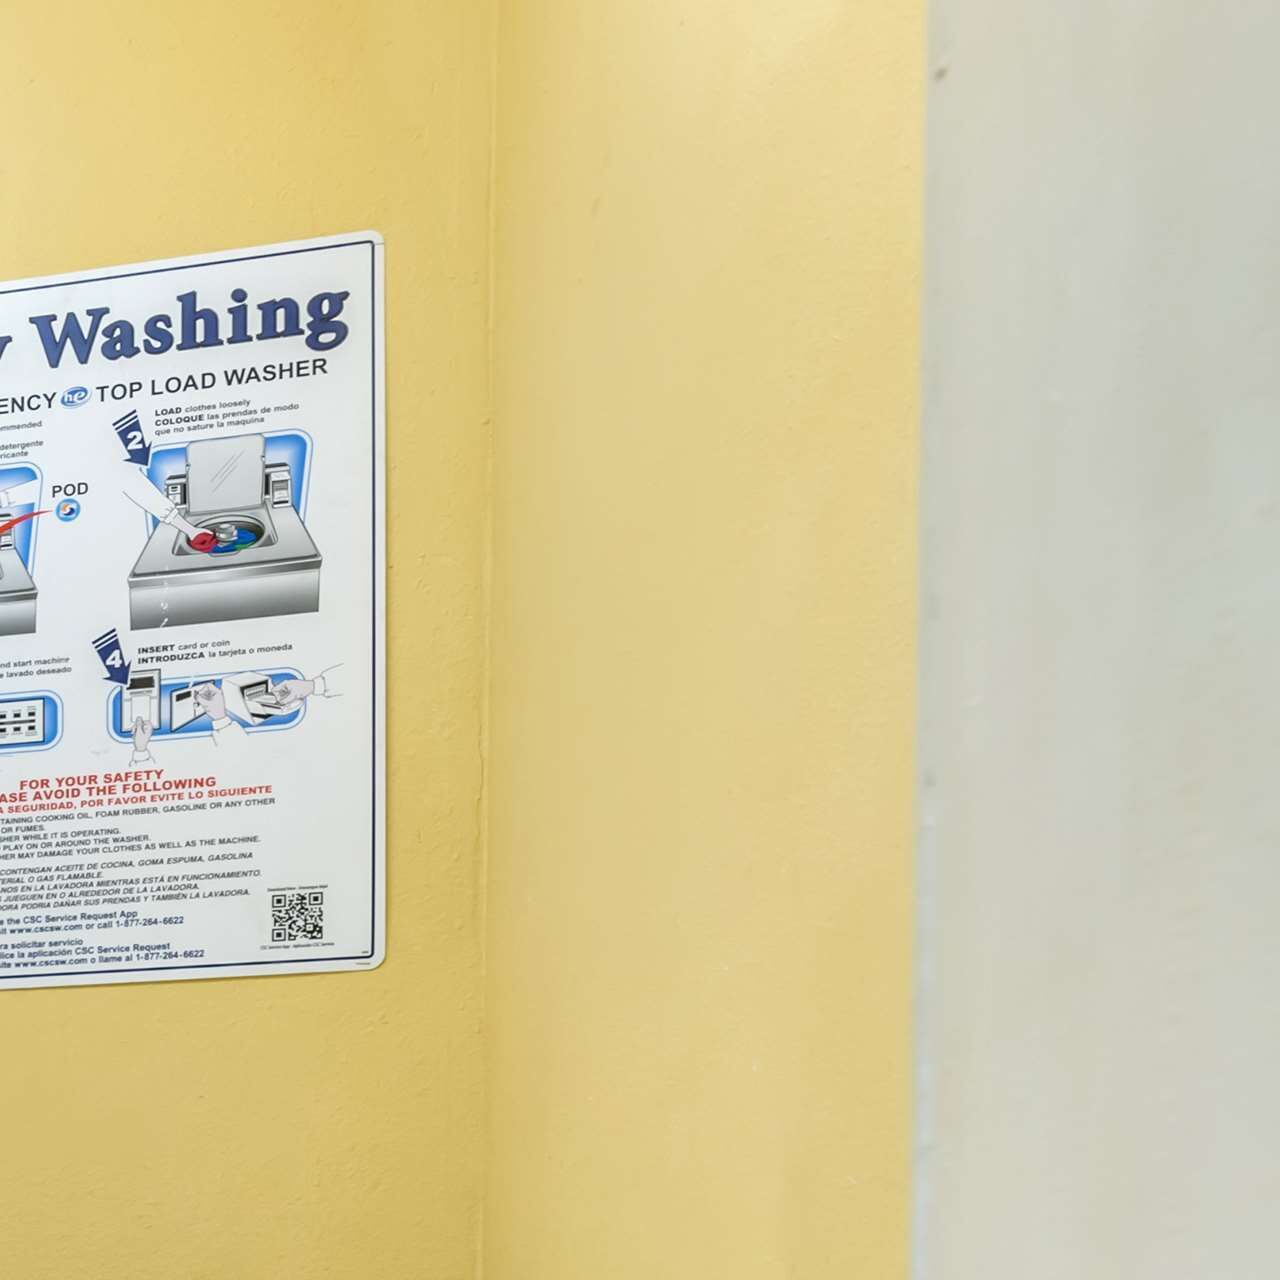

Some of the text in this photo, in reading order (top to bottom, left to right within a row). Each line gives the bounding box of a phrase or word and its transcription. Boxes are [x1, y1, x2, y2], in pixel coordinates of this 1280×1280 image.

[28, 287, 350, 369] Washing
[95, 357, 327, 402] TOP LOAD WASHER
[154, 399, 250, 416] LOAD clothes loosely
[125, 429, 144, 451] 2
[51, 481, 88, 498] POD
[104, 648, 122, 670] 4
[137, 643, 175, 654] INSERT
[178, 642, 197, 650] card
[19, 768, 164, 790] FOR YOUR SAFETY
[32, 787, 80, 801] AVOID
[85, 784, 116, 796] THE
[122, 776, 216, 794] FOLLOWING
[7, 801, 76, 814] SEGURIDAD,
[80, 798, 104, 808] POR
[107, 795, 146, 806] FAVOR
[150, 792, 184, 802] EVITE
[188, 790, 203, 800] LO
[207, 784, 272, 798] SIGUIENTE
[9, 923, 83, 934] www.cscsw.com
[96, 920, 113, 929] call
[22, 915, 42, 924] CSC
[44, 914, 77, 923] Service
[79, 911, 118, 921] Request
[117, 910, 139, 921] App
